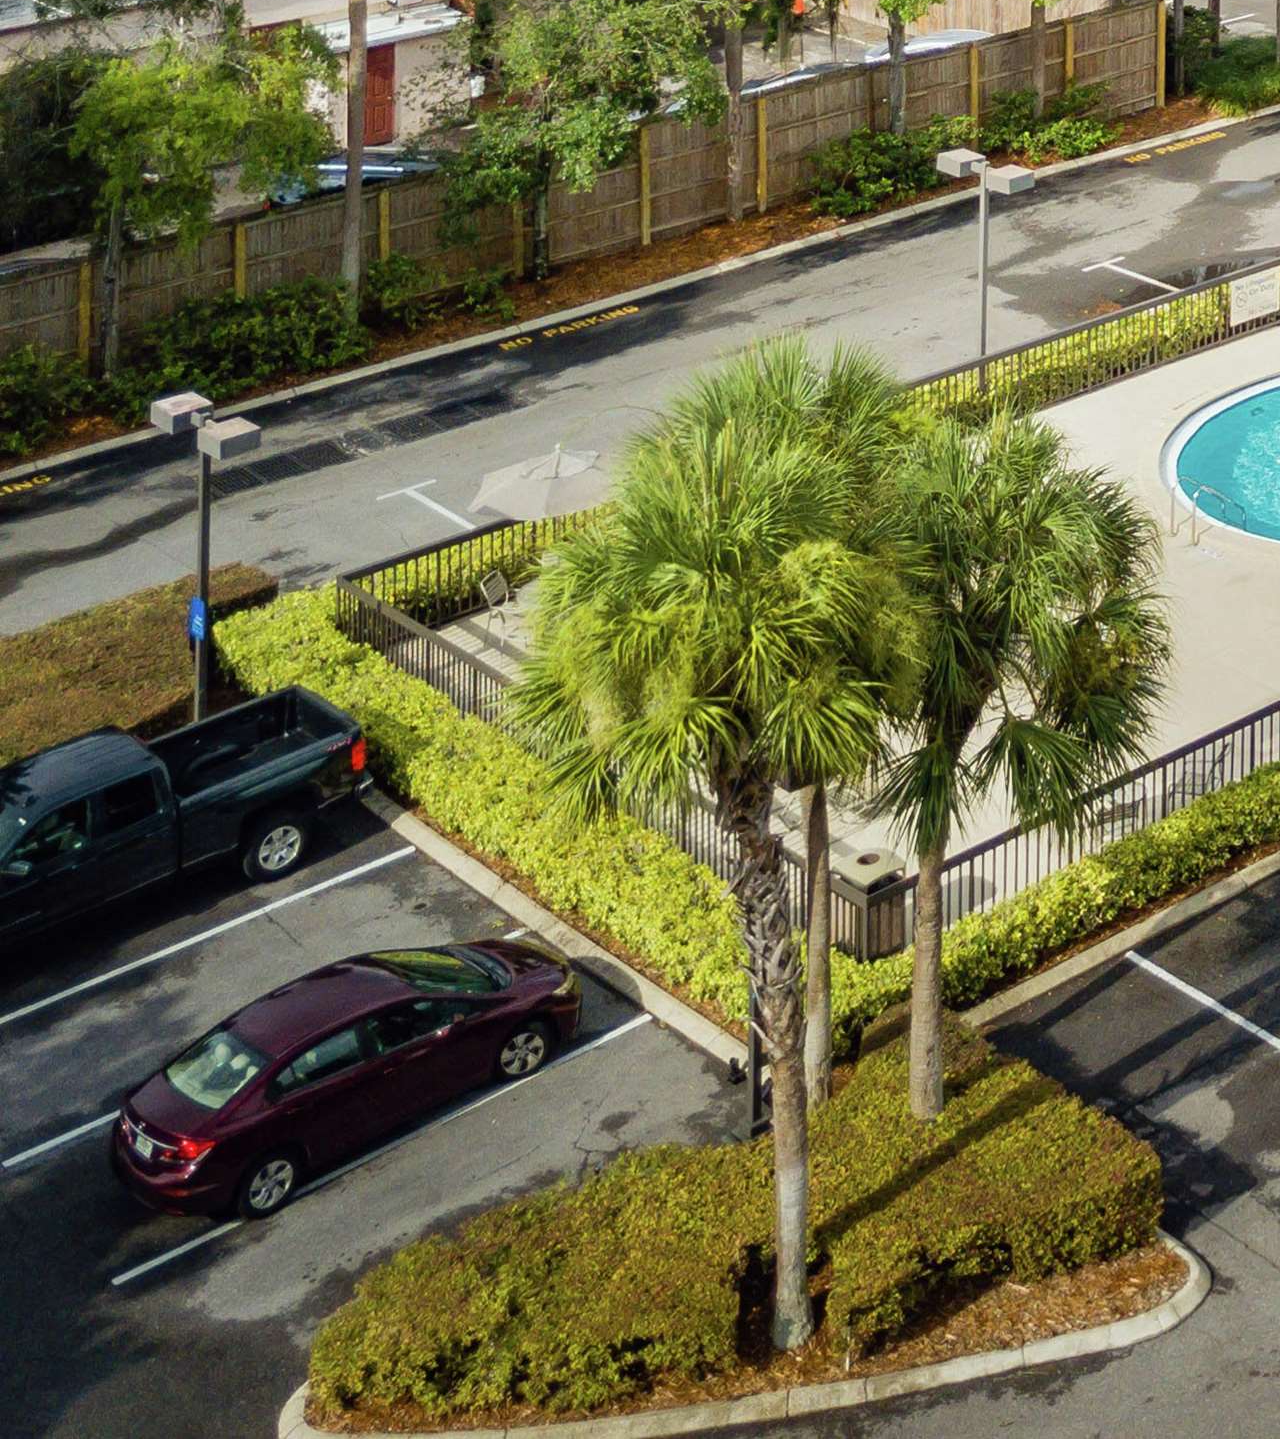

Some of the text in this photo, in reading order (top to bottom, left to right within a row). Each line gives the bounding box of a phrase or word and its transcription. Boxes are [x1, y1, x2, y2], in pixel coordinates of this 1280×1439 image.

[1123, 131, 1227, 164] NO PARKING
[498, 305, 640, 352] NO PARKING
[0, 474, 52, 497] ING
